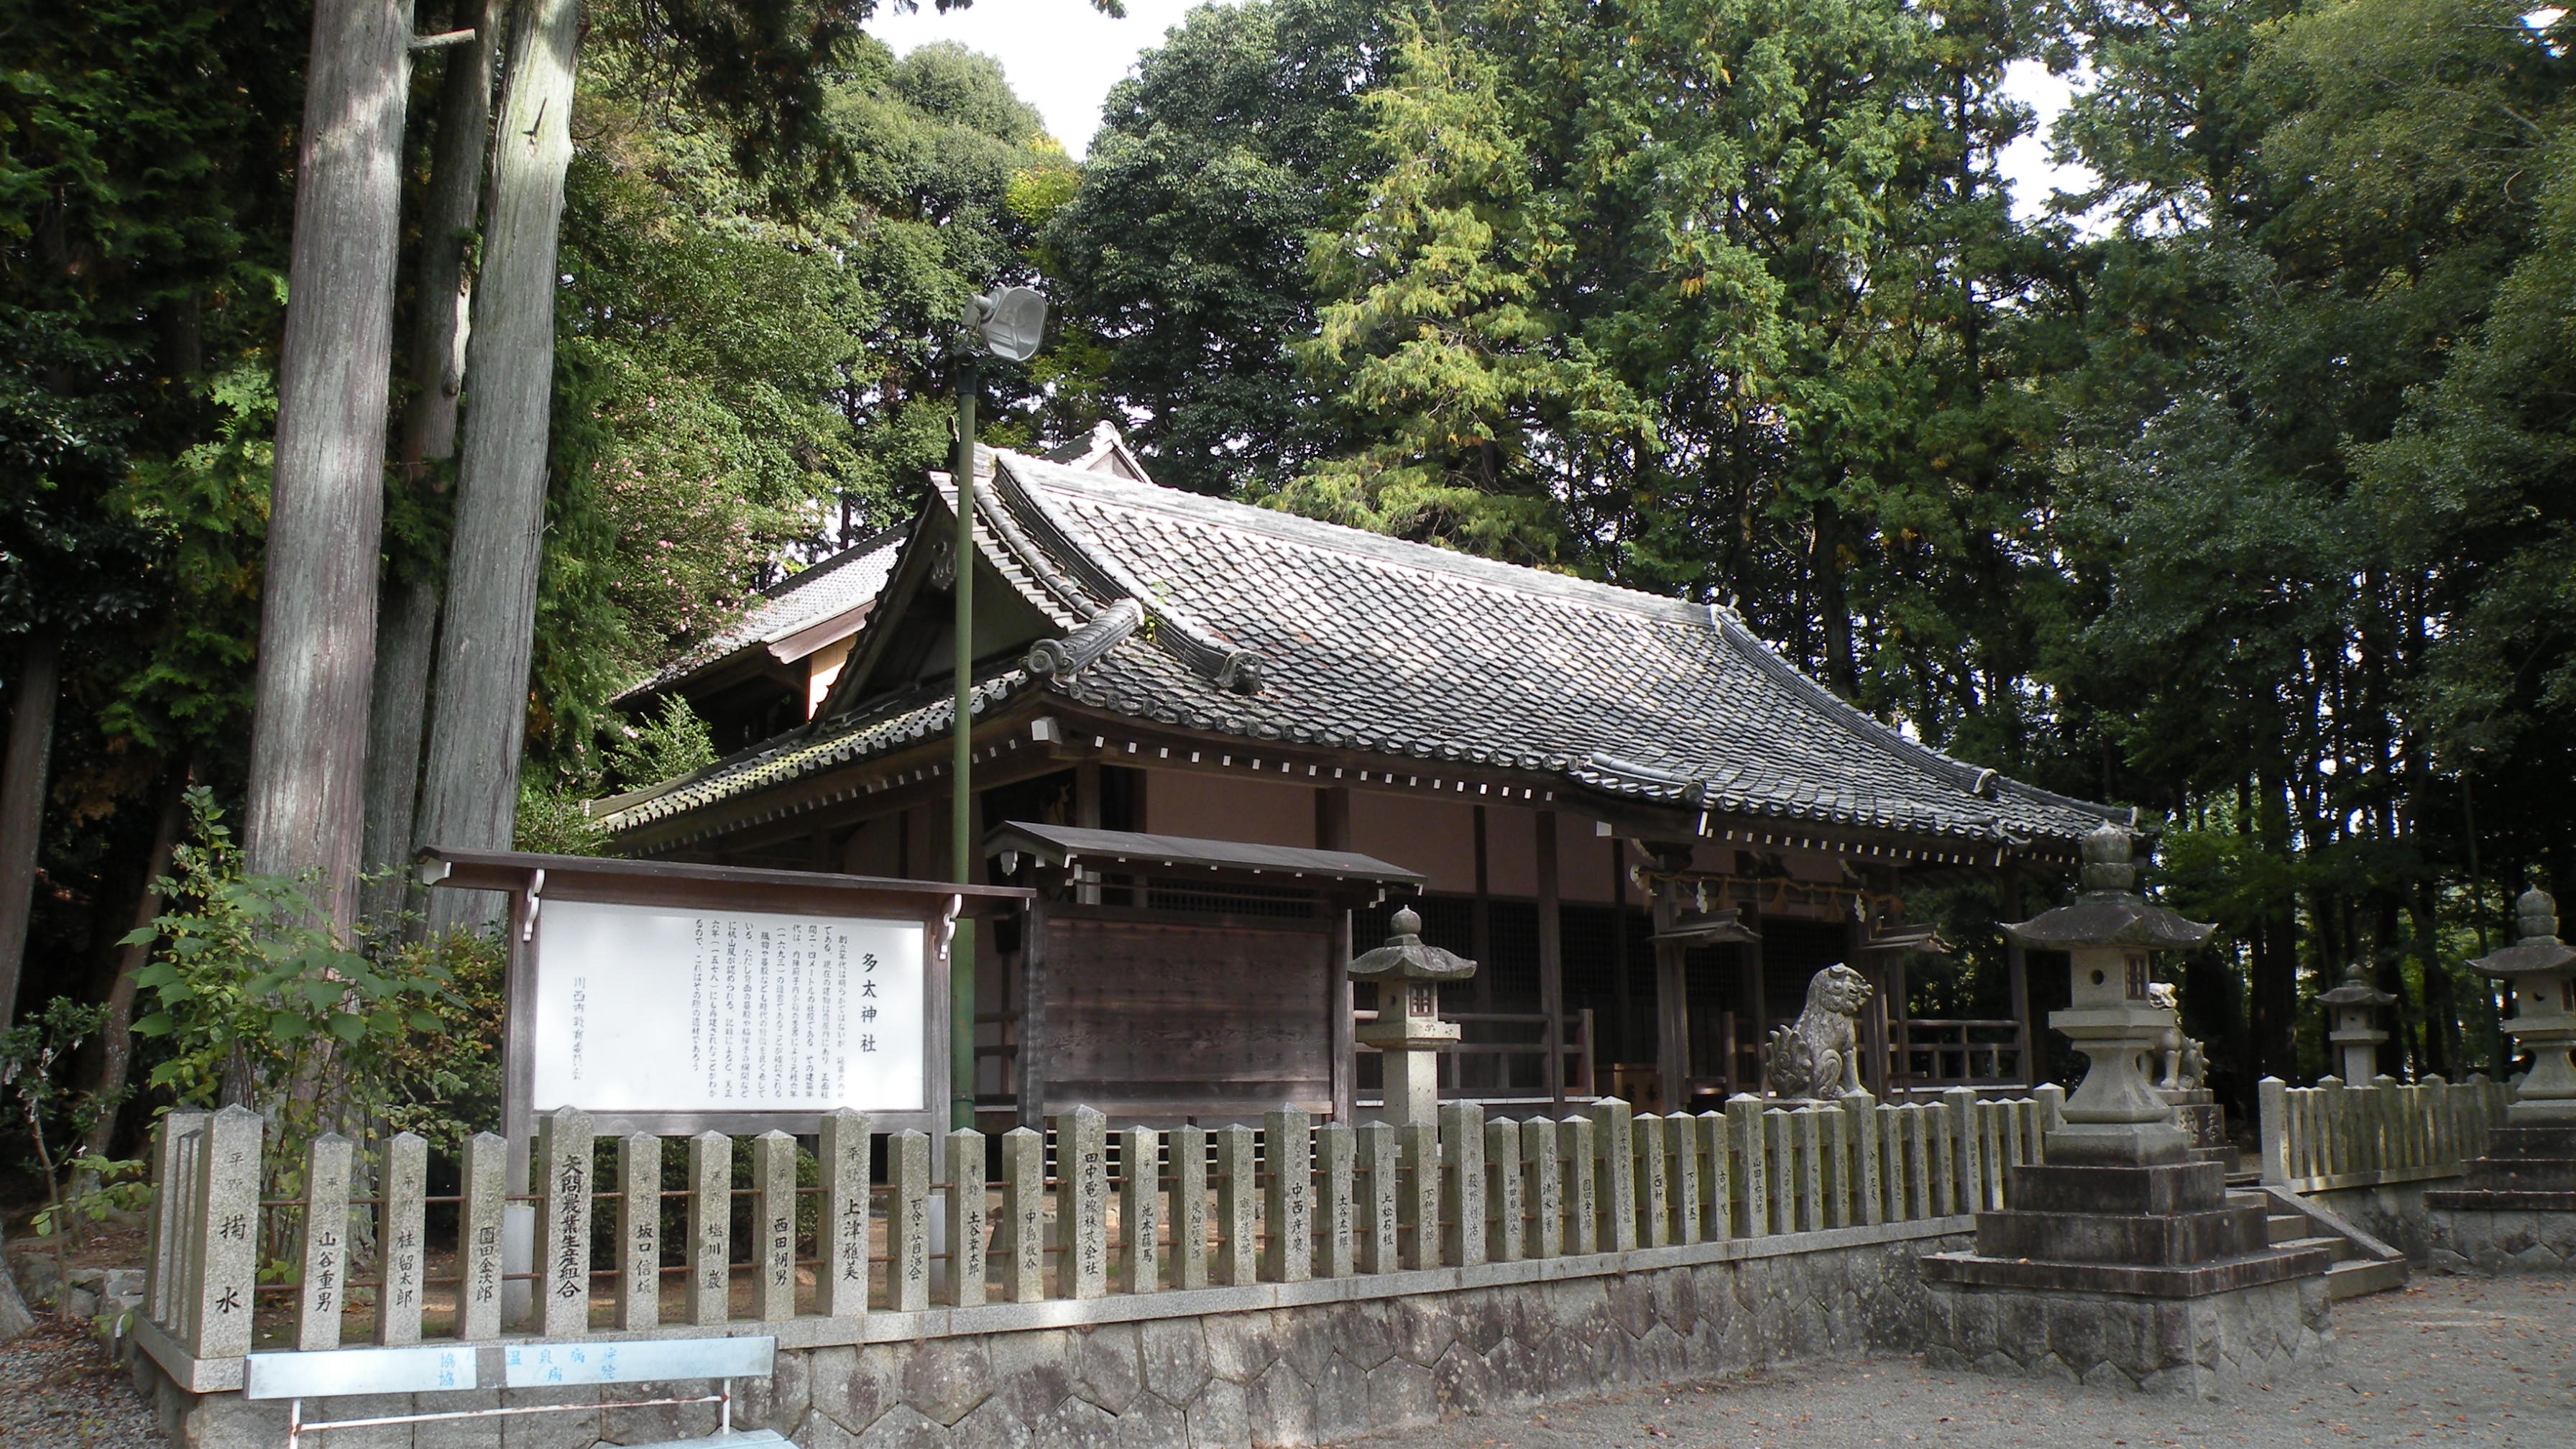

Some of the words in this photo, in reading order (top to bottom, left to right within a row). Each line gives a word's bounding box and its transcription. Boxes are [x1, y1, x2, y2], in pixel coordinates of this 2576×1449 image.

[860, 952, 878, 1052] 多太神社
[315, 1231, 336, 1312] 山谷重男
[397, 1230, 416, 1307] 桂留太郎
[476, 1227, 495, 1303] 園田金次郎
[774, 1218, 788, 1287] 西田朝男
[843, 1199, 861, 1281] 上津雅美
